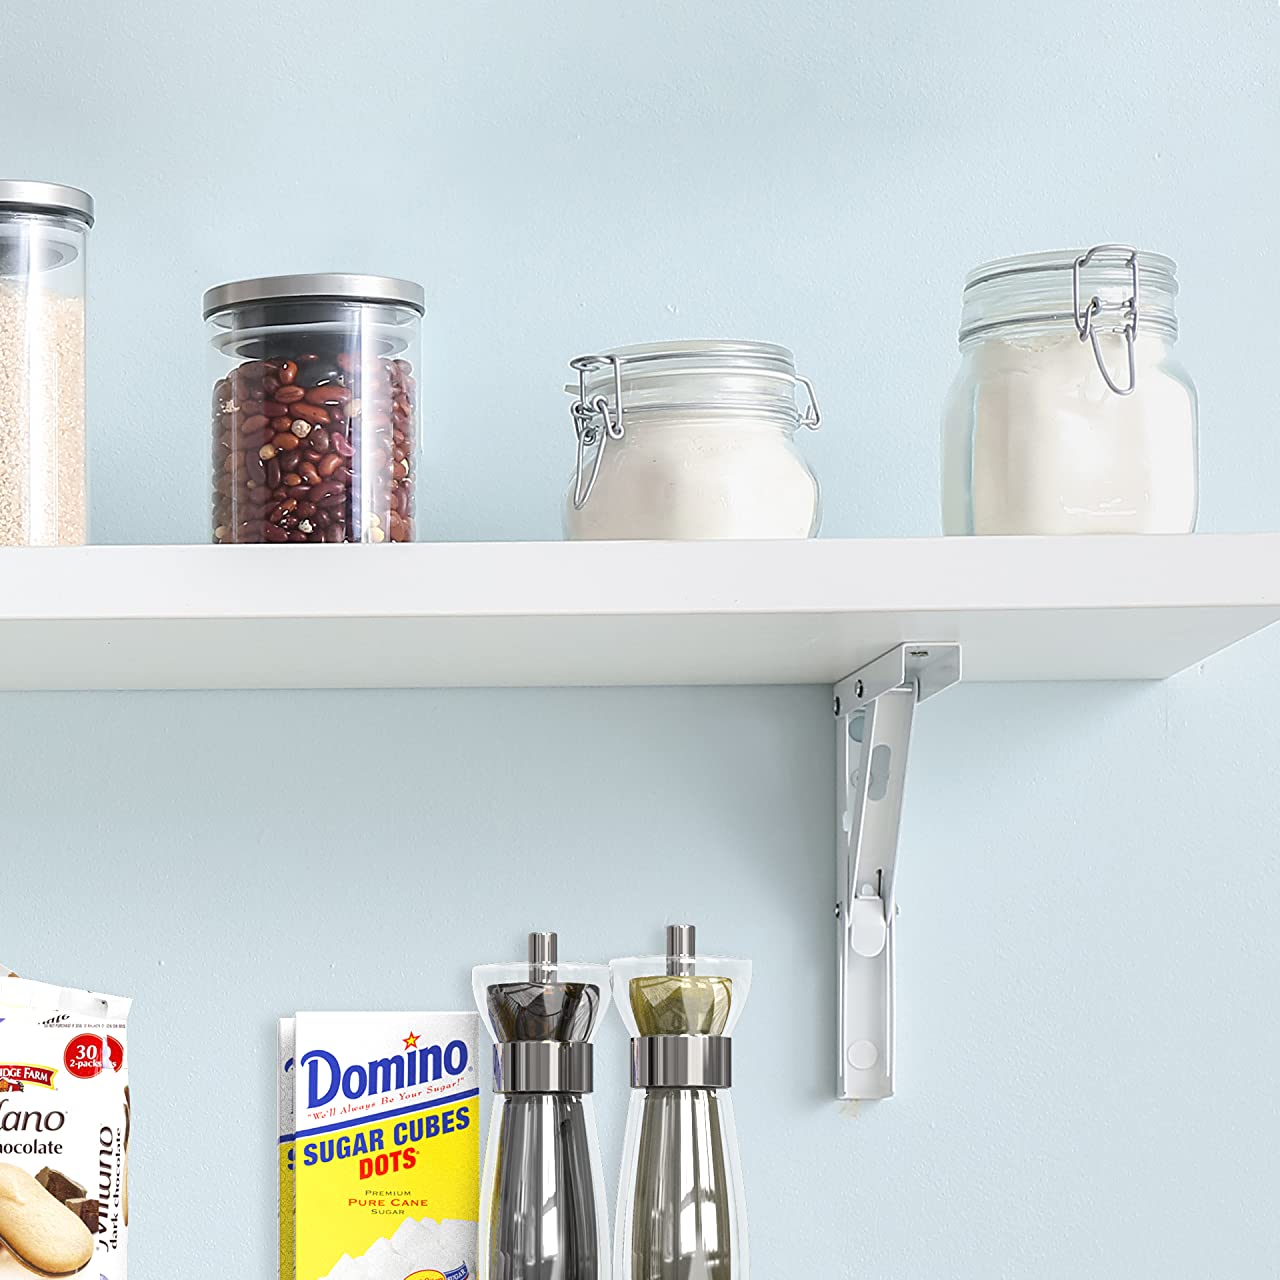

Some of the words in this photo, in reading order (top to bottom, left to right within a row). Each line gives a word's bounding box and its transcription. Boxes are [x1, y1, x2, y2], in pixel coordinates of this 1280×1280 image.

[69, 1059, 102, 1069] 2-packs
[76, 1044, 98, 1060] 30
[23, 1066, 48, 1083] FARM
[300, 1036, 468, 1110] Domino
[339, 1102, 376, 1115] Always
[381, 1096, 395, 1106] Be
[399, 1090, 423, 1102] Your
[303, 1128, 384, 1166] SUGAR
[393, 1106, 470, 1146] CUBES
[112, 1127, 122, 1208] chocolate
[359, 1147, 417, 1181] DOTS
[348, 1198, 385, 1207] PURE
[390, 1198, 428, 1207] CANE
[365, 1189, 411, 1197] PREMIUM
[109, 1212, 119, 1250] dark
